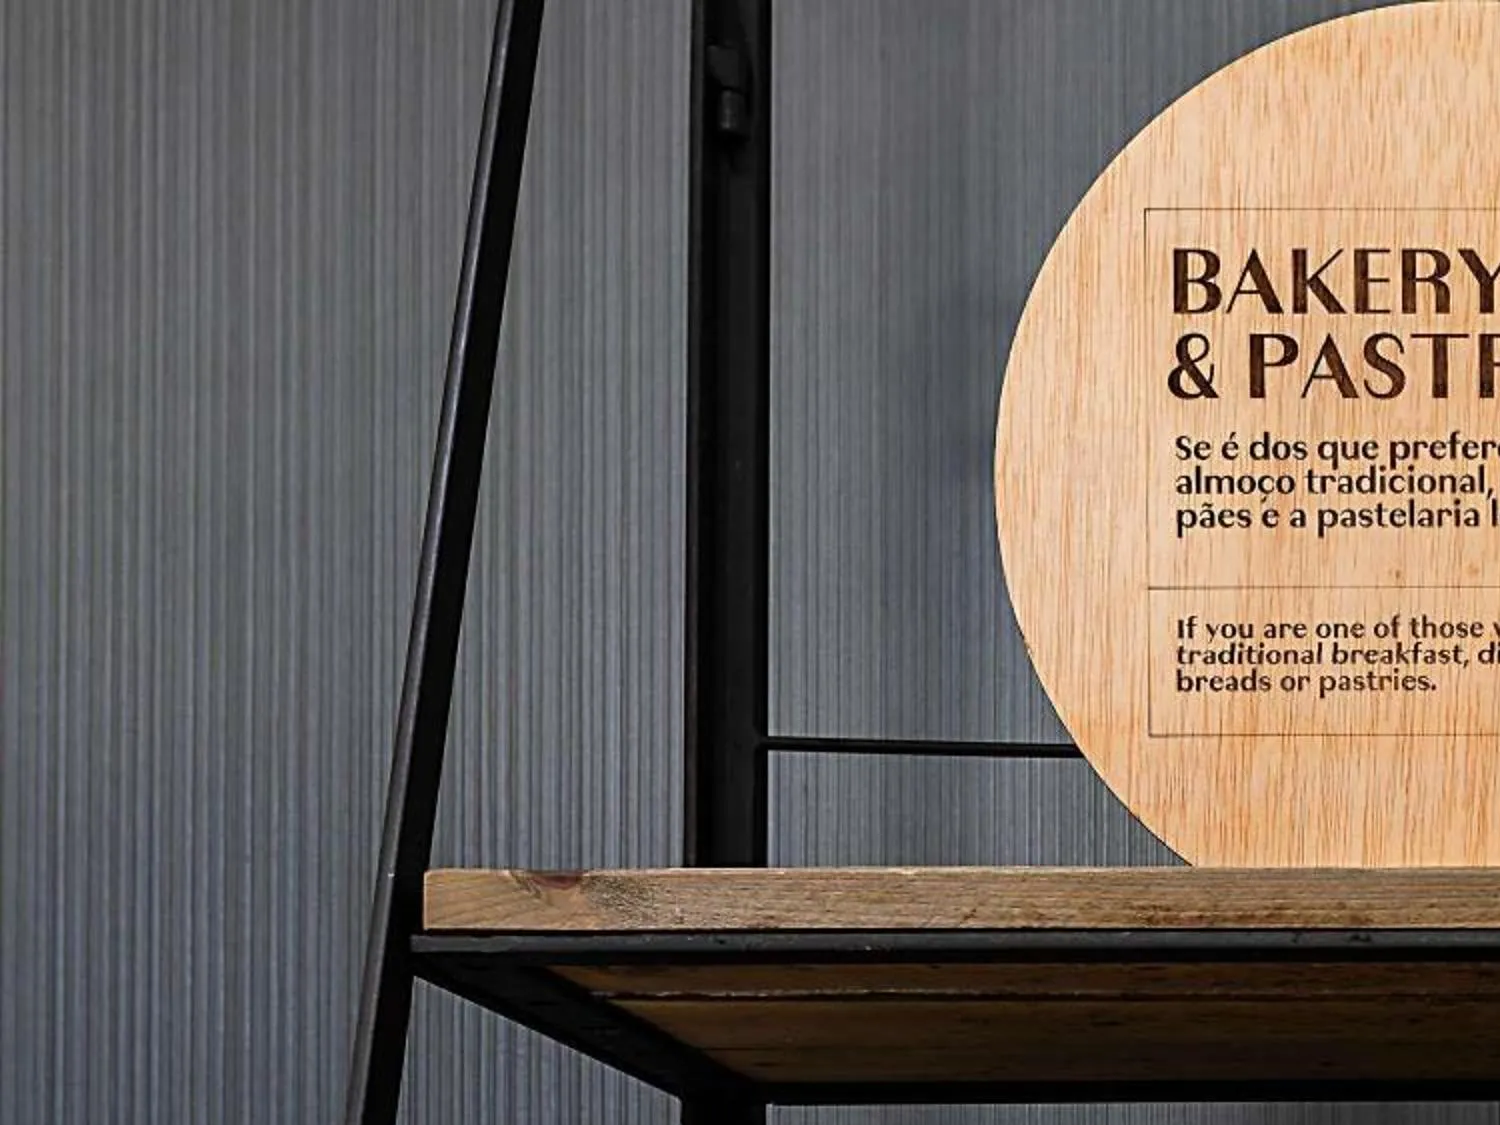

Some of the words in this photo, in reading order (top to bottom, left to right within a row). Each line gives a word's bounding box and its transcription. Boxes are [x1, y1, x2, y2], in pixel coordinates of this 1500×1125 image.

[1167, 332, 1220, 400] &
[1175, 435, 1211, 461] Se
[1221, 431, 1239, 461] é
[1249, 431, 1309, 461] dos
[1317, 440, 1379, 471] que
[1175, 465, 1297, 503] almoço
[1306, 464, 1494, 501] tradicional,
[1176, 502, 1253, 539] pães
[1289, 508, 1307, 529] a
[1317, 498, 1480, 539] pastelaria
[1177, 615, 1197, 639] If
[1204, 622, 1254, 643] you
[1263, 623, 1308, 639] are
[1315, 622, 1365, 639] one
[1373, 614, 1401, 639] of
[1409, 614, 1484, 639] those
[1176, 641, 1323, 665] traditional
[1331, 641, 1469, 669] breakfast,
[1176, 668, 1272, 693] breads
[1280, 675, 1311, 692] or
[1319, 667, 1437, 700] pastries.
